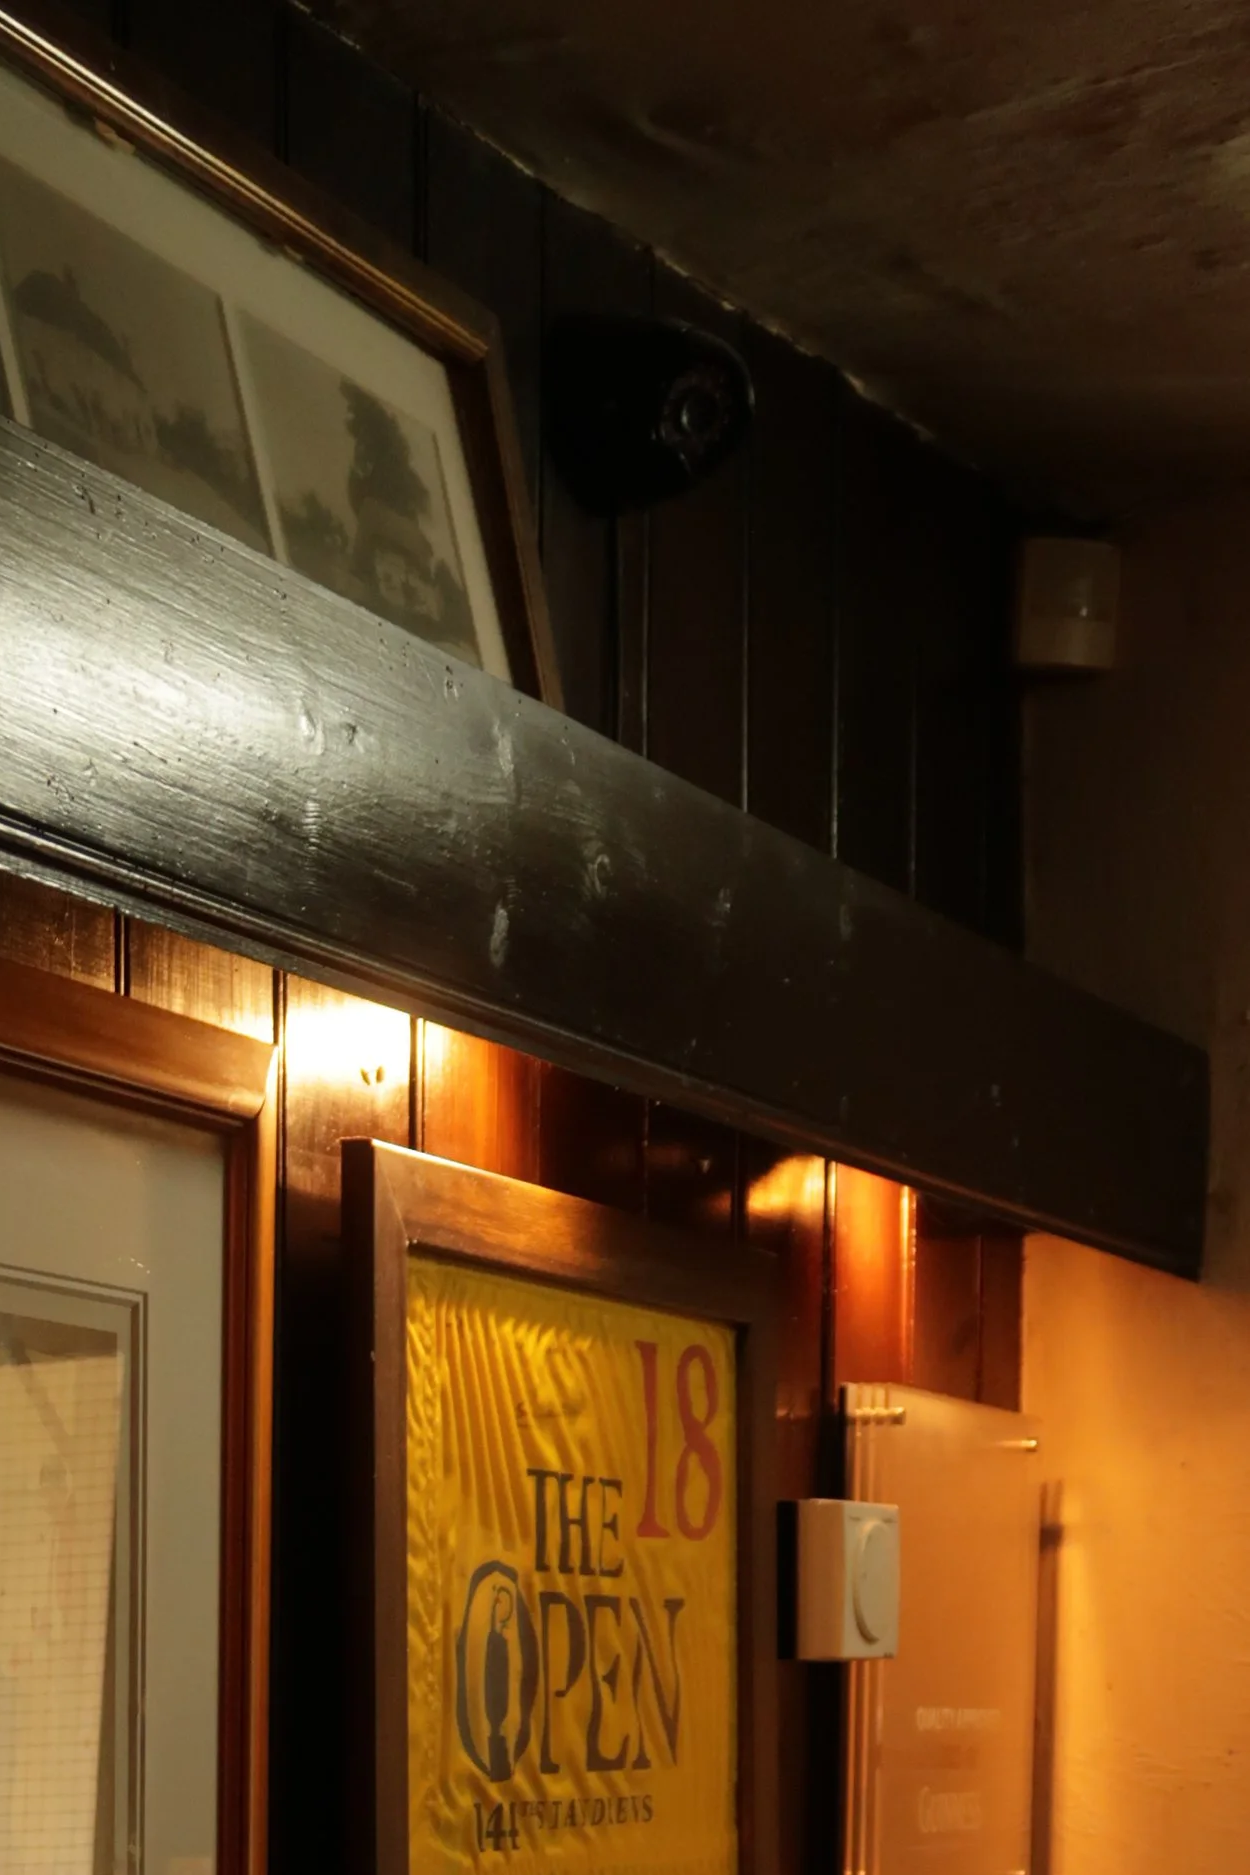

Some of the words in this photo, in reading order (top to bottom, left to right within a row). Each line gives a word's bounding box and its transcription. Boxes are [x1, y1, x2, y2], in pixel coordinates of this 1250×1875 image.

[527, 1467, 624, 1578] THE
[636, 1339, 723, 1541] 18
[456, 1560, 685, 1783] OPEN
